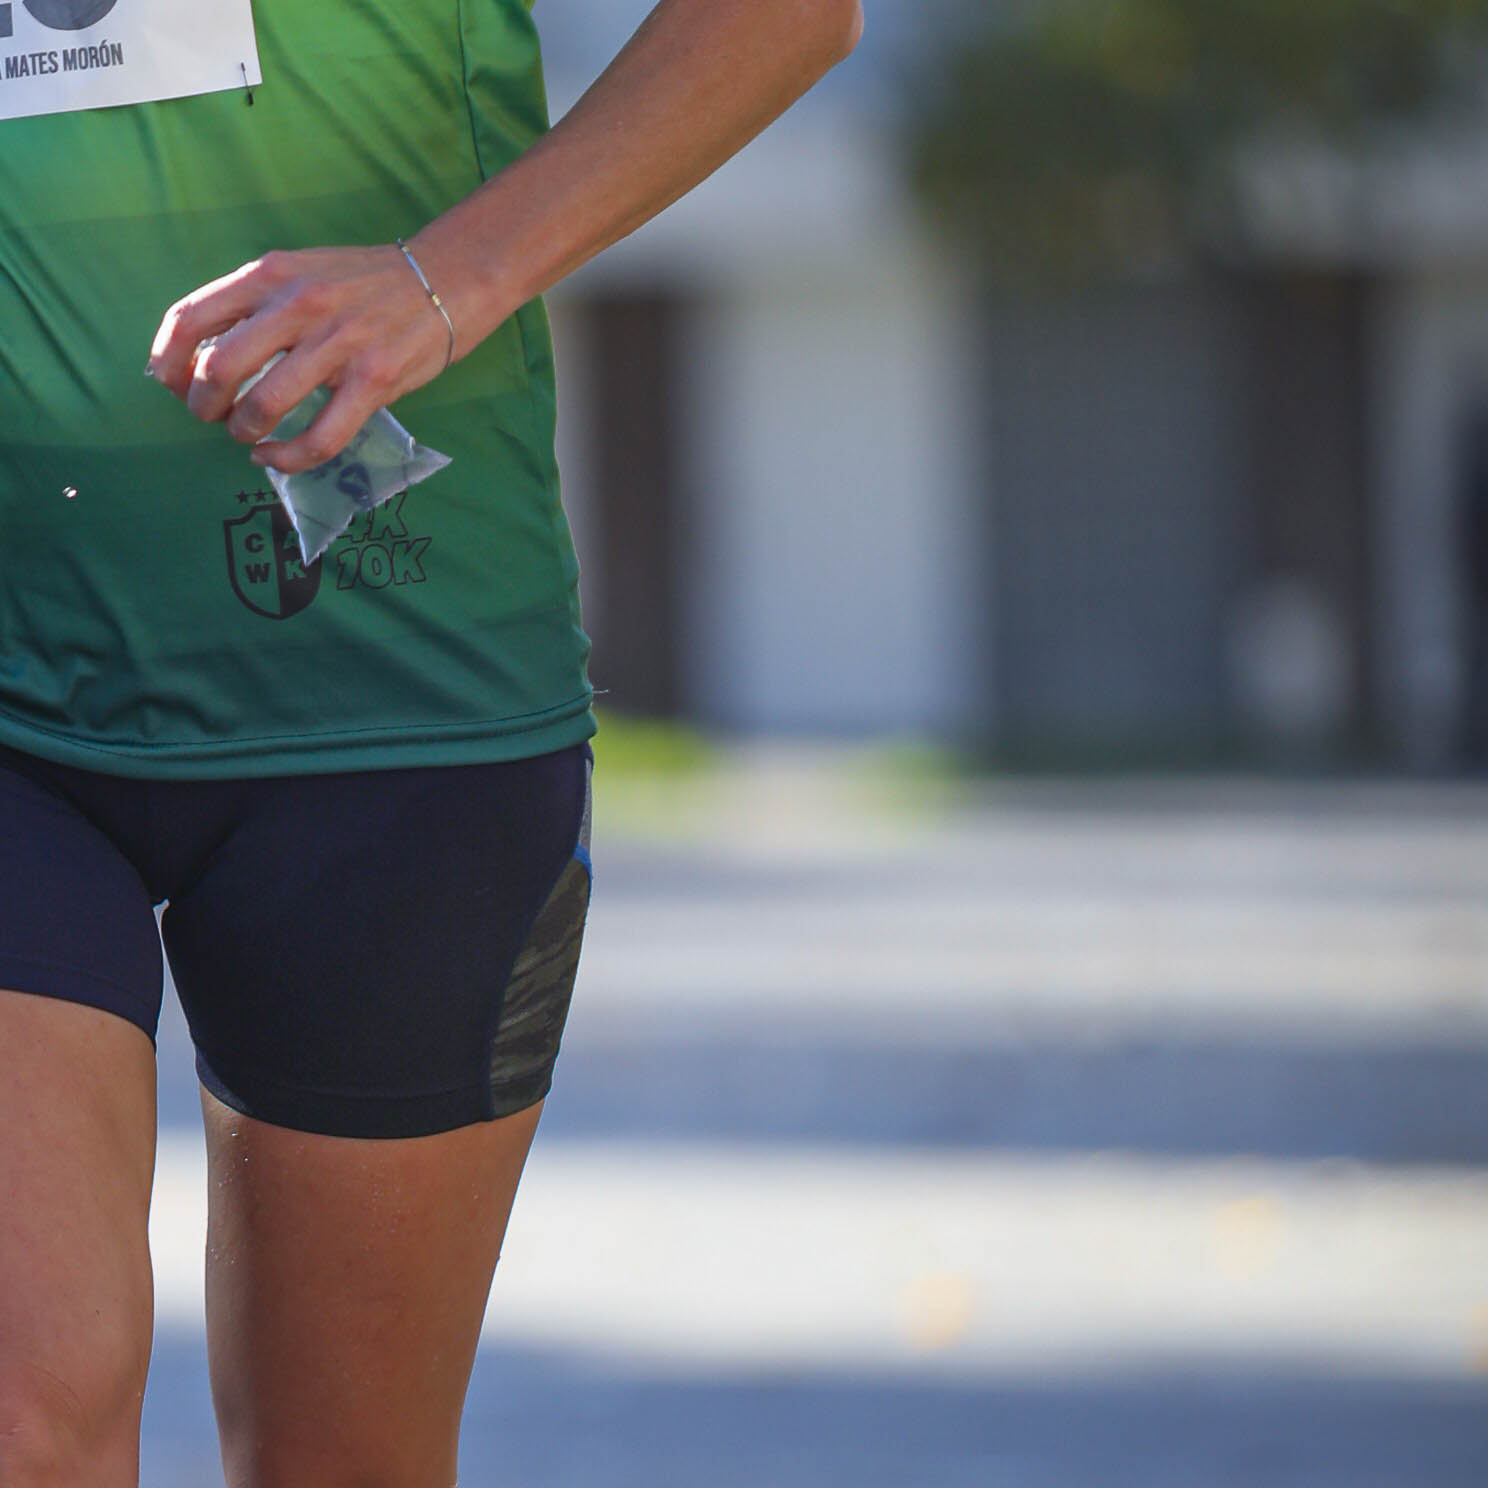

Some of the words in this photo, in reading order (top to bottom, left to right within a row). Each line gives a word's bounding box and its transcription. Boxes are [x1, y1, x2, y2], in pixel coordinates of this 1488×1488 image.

[5, 50, 59, 79] MATES
[62, 39, 124, 72] MORÓN
[336, 536, 432, 591] 10K
